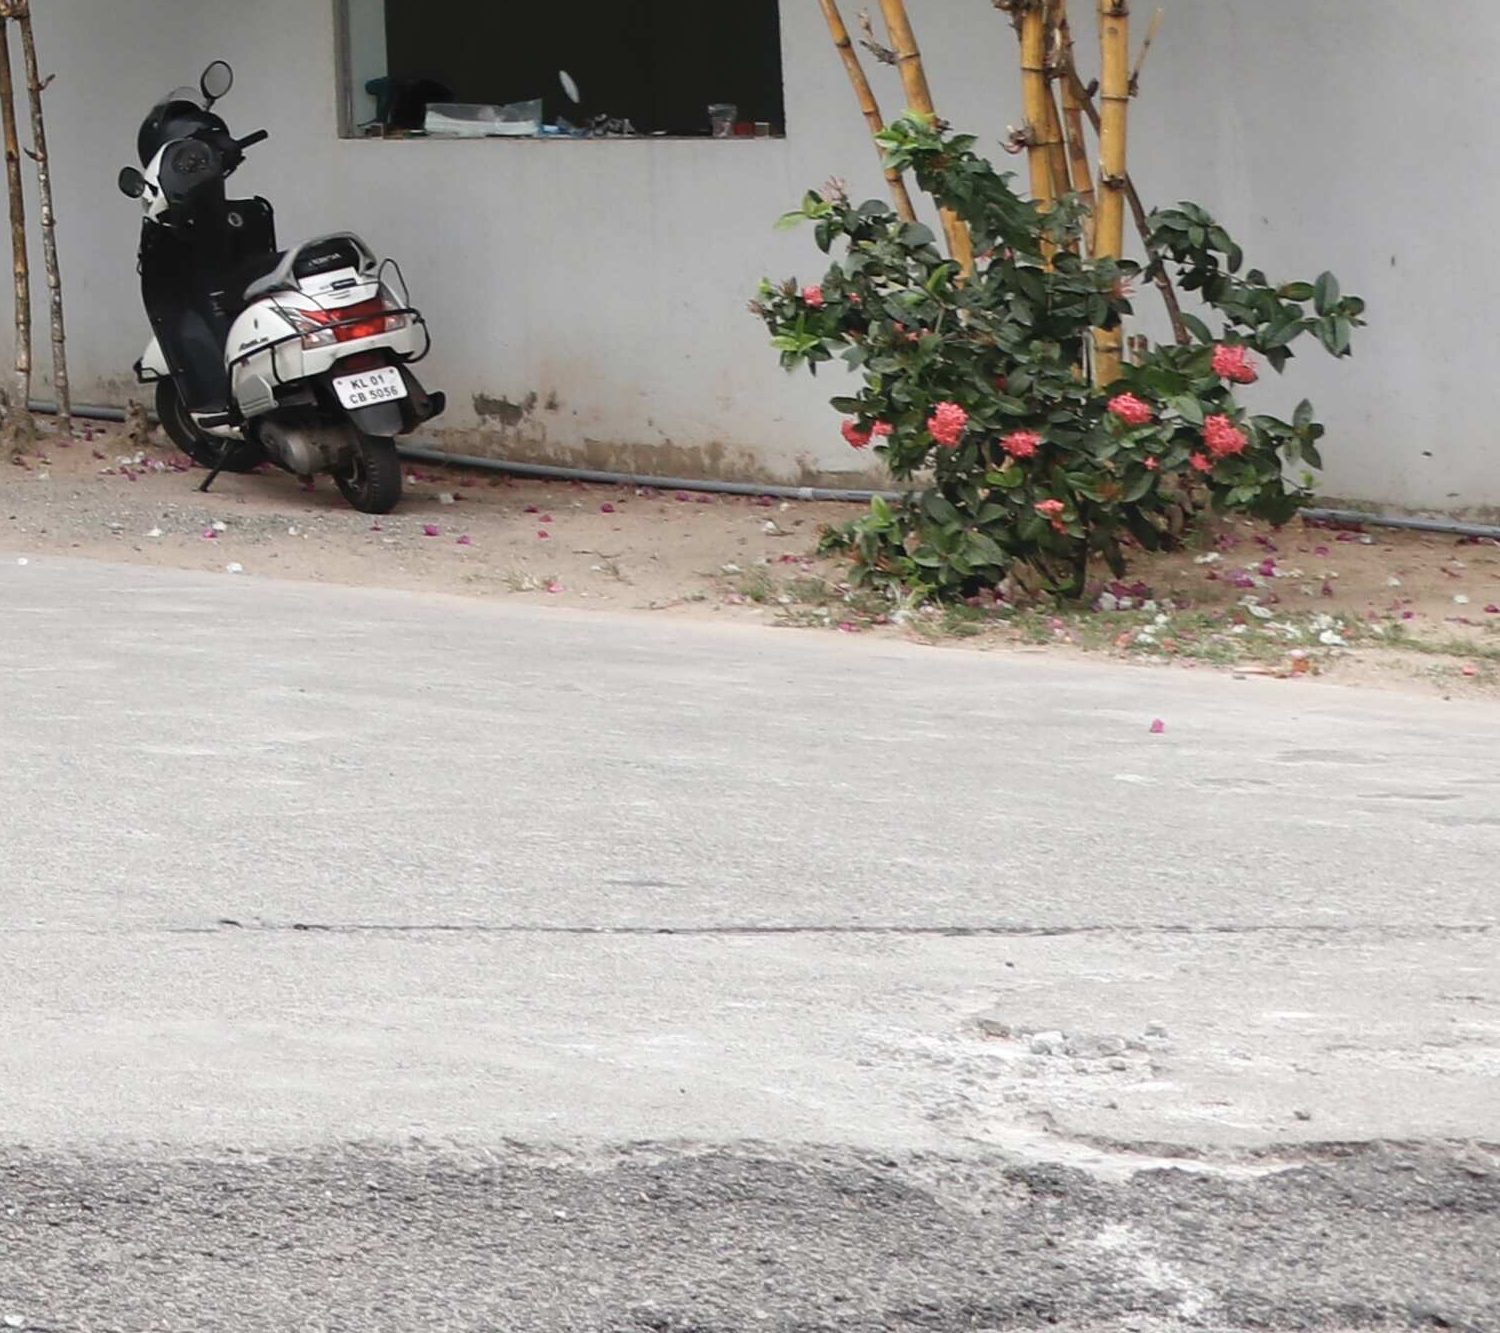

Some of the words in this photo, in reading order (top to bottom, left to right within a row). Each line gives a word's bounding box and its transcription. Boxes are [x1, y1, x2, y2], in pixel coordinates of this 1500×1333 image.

[350, 378, 368, 390] KL
[369, 374, 385, 386] 01
[349, 392, 367, 404] CB
[369, 385, 399, 400] 5056
